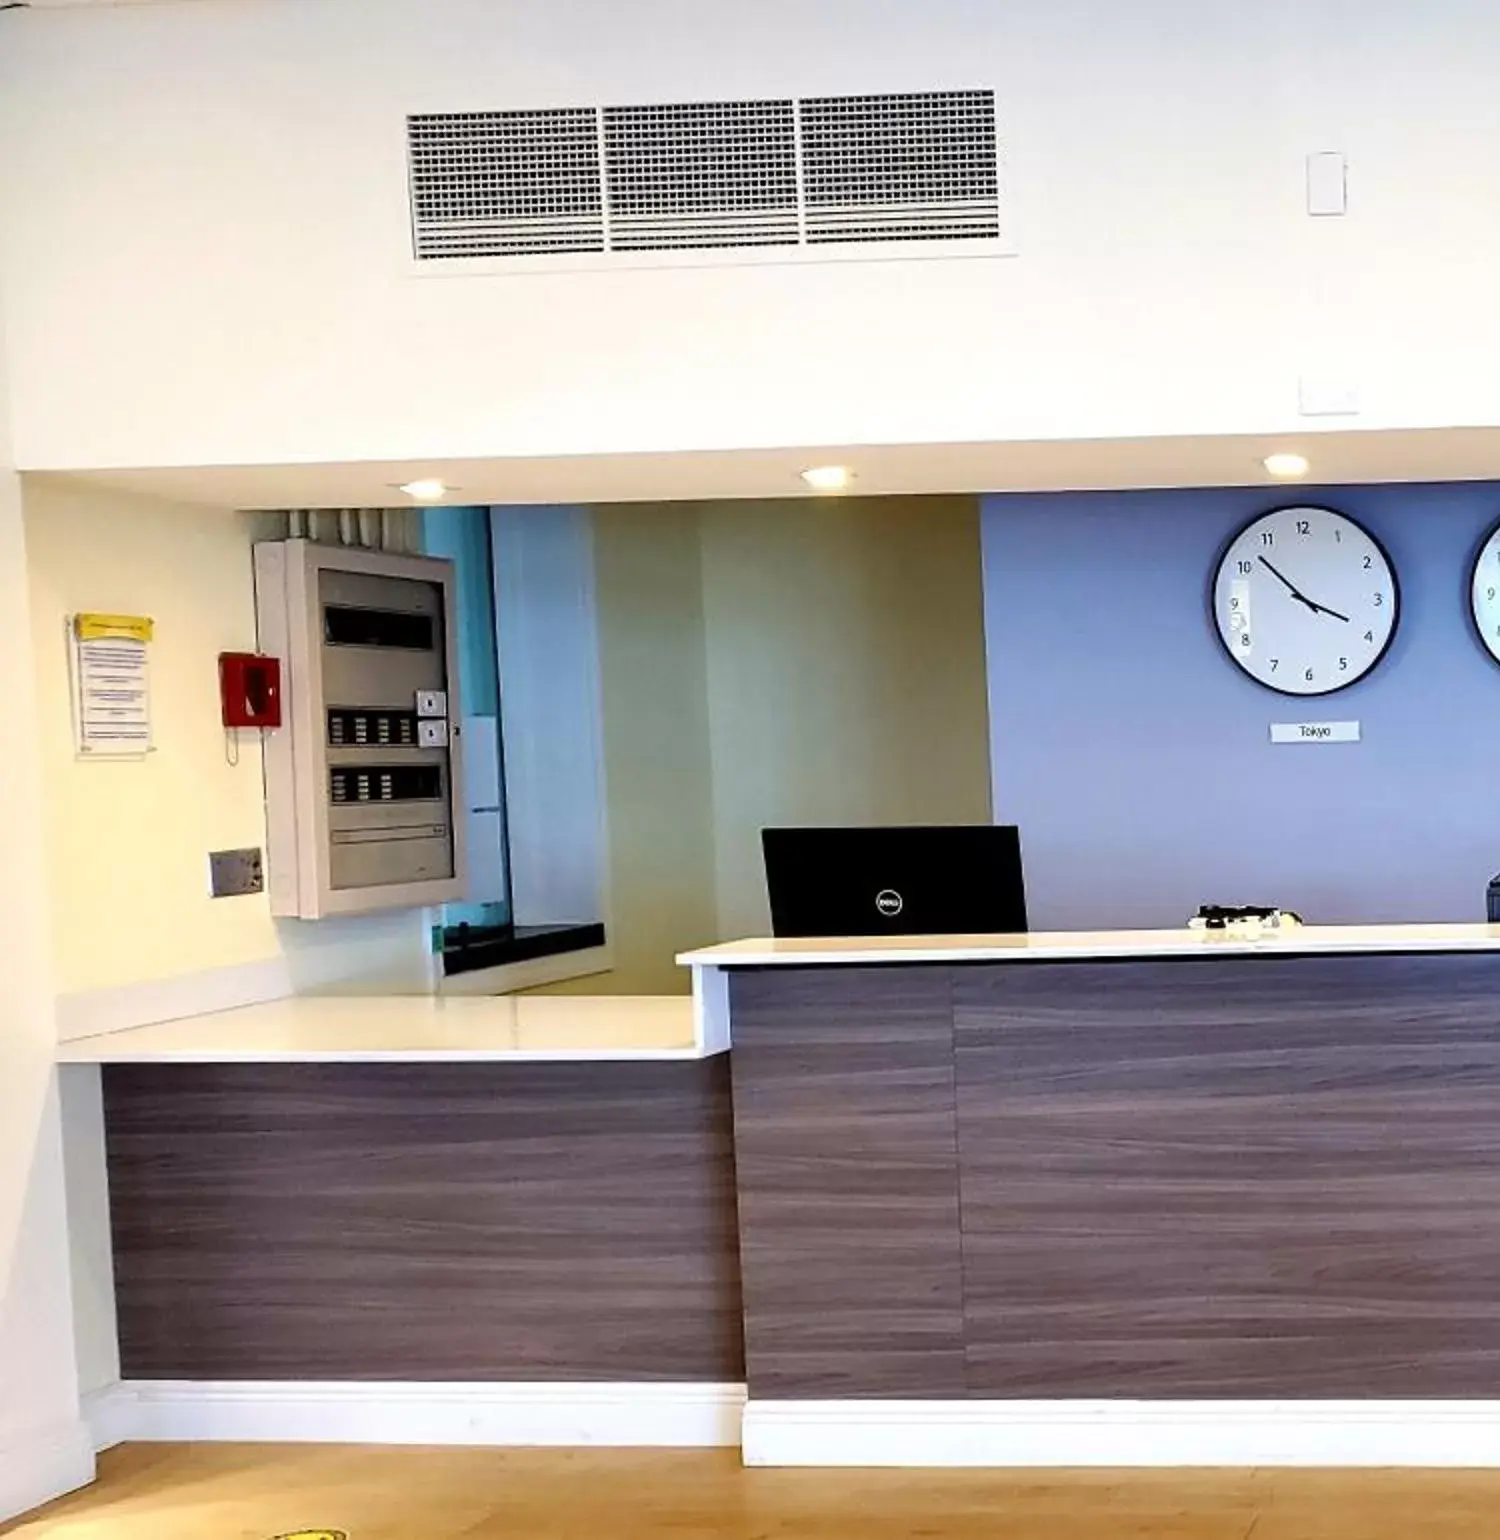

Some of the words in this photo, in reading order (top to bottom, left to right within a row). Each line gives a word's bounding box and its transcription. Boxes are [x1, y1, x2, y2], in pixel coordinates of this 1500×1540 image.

[1296, 521, 1310, 534] 12
[1261, 533, 1273, 545] 11
[1238, 561, 1251, 574] 10
[1363, 556, 1372, 569] 2
[1373, 593, 1383, 606] 3
[1487, 588, 1495, 600] 9
[1230, 598, 1239, 610] 9
[1241, 634, 1250, 646] 8
[1364, 630, 1373, 642] 4
[1270, 659, 1279, 672] 7
[1339, 657, 1347, 670] 5
[1305, 668, 1313, 681] 6
[1298, 725, 1331, 738] Tokyo
